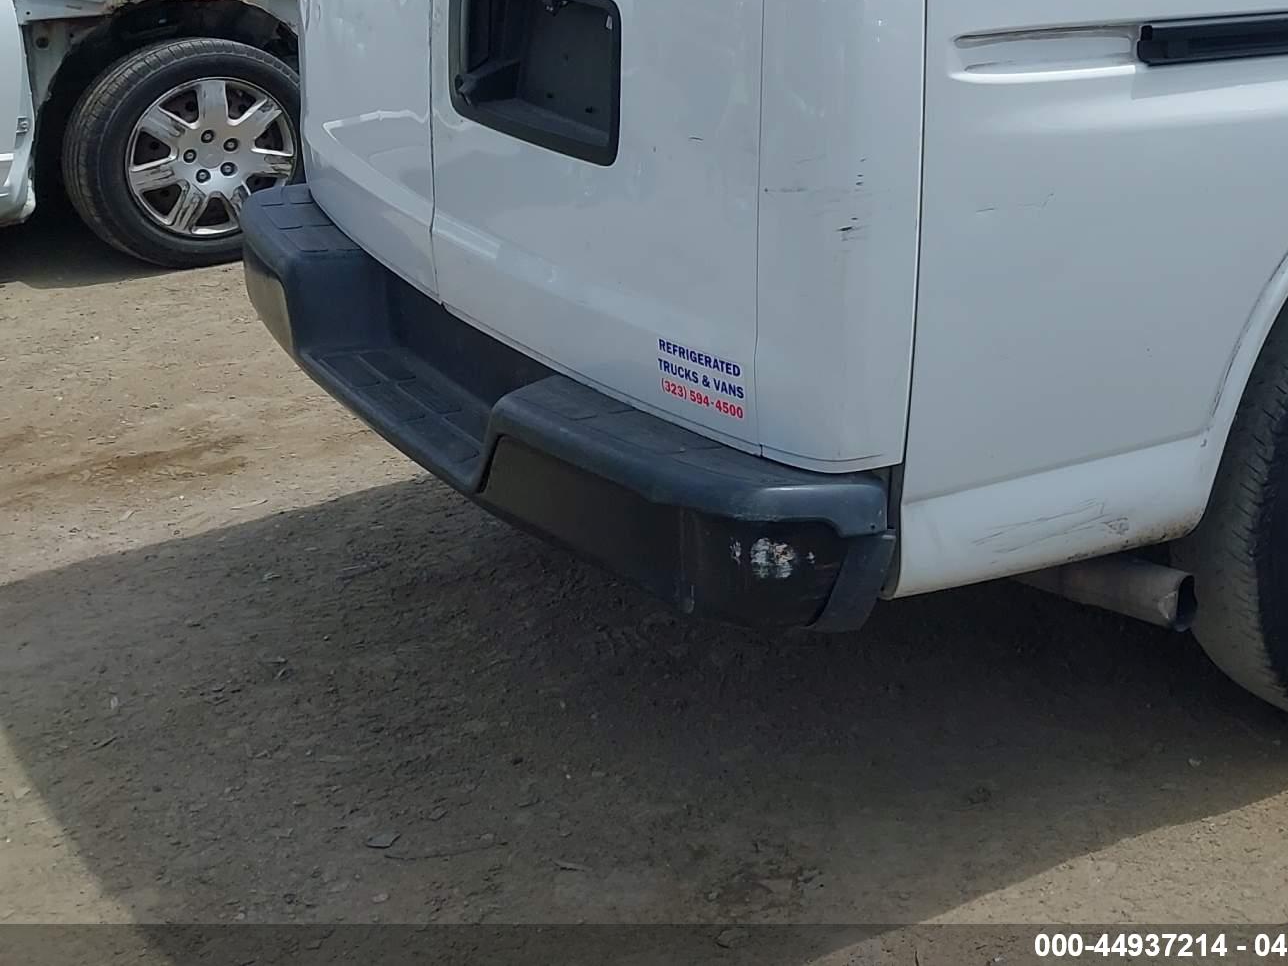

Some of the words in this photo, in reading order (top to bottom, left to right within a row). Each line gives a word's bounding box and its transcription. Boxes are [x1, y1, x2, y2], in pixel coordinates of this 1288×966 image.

[659, 338, 741, 377] REFRIGERATED
[658, 358, 698, 384] TRUCKS
[702, 375, 710, 388] &
[713, 378, 744, 399] VANS
[661, 378, 687, 400] (323)
